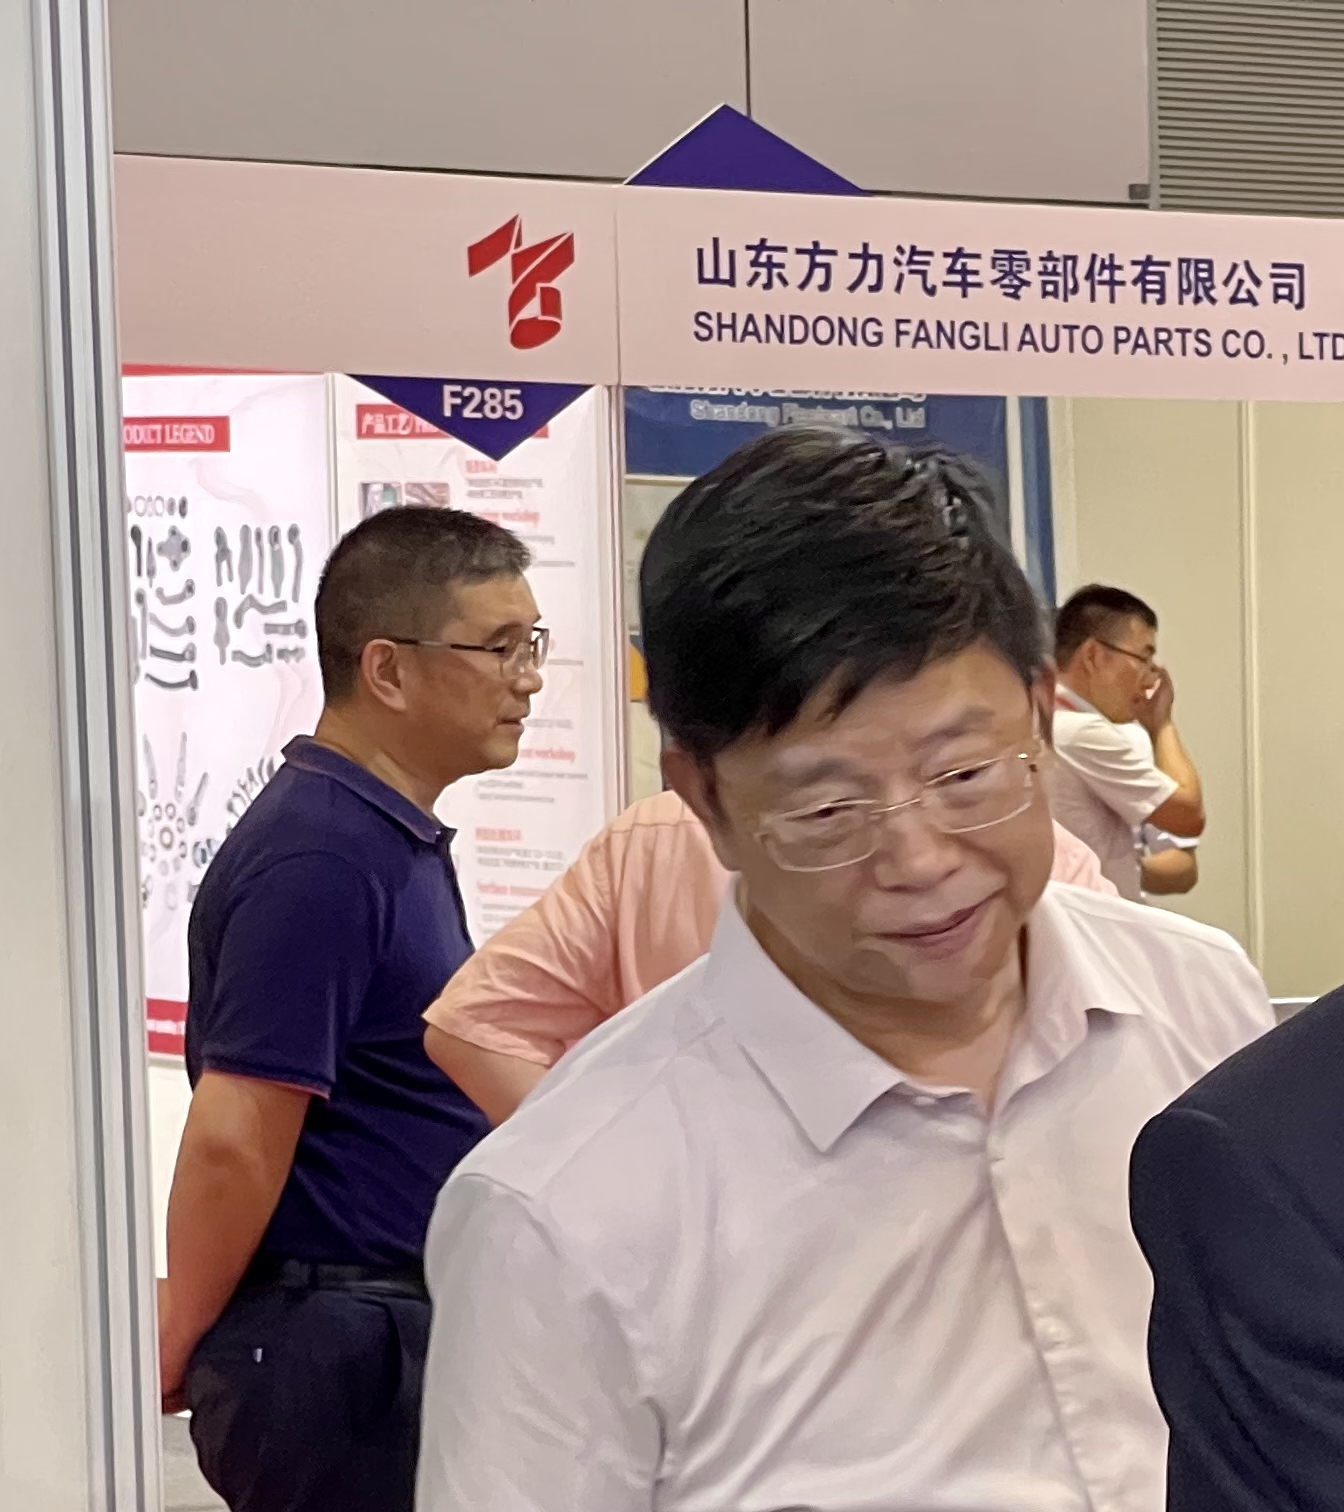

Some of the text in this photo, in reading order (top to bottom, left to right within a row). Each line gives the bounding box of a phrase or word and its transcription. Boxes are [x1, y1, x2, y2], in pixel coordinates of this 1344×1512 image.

[696, 236, 1306, 311] 山东方力汽车零部件有限公司
[693, 310, 884, 348] SHANDONG
[894, 317, 1009, 352] FANGLI
[1017, 323, 1104, 355] AUTO
[1113, 325, 1213, 358] PARTS
[443, 385, 524, 420] F285
